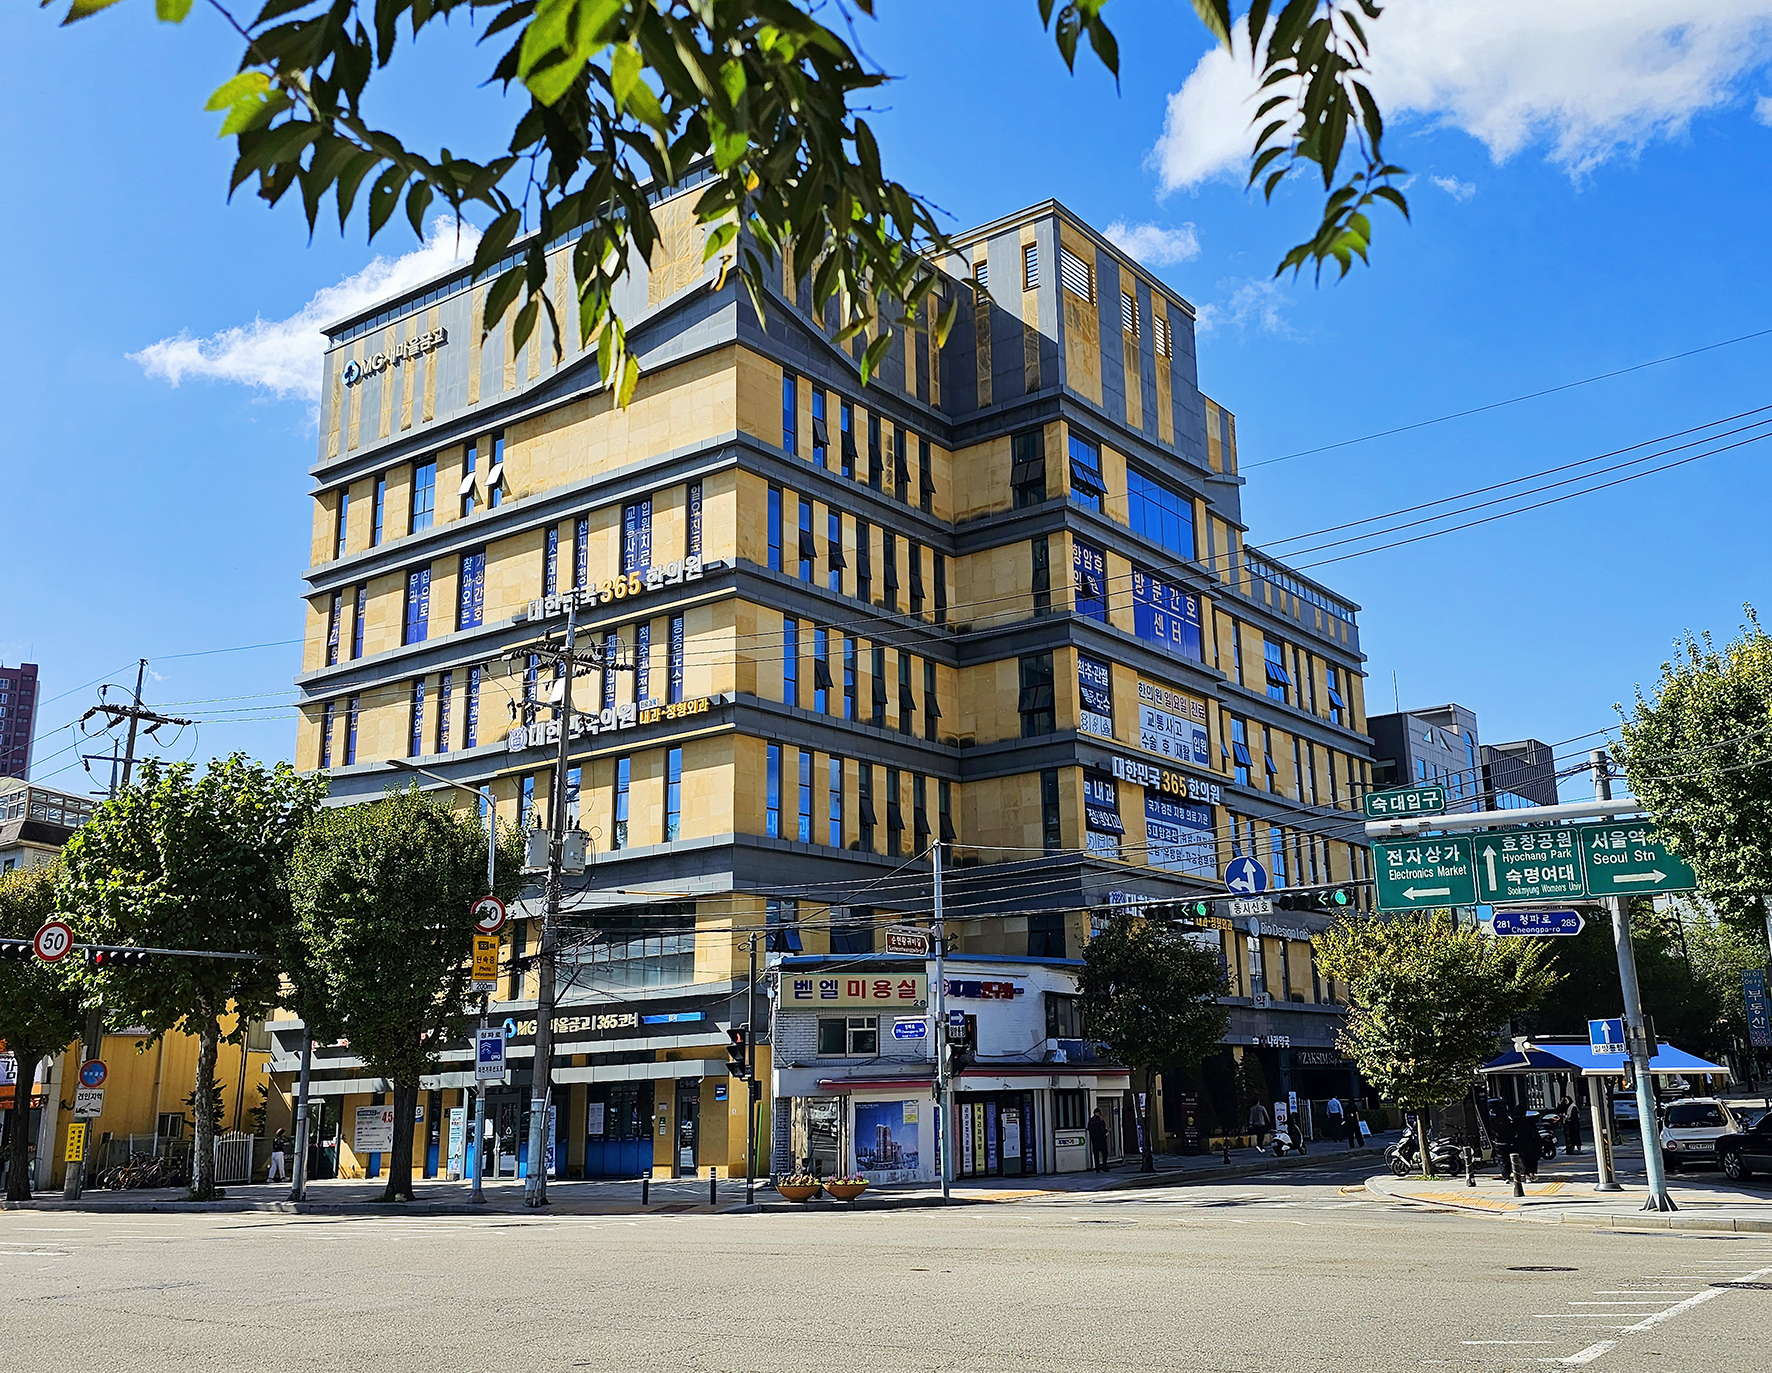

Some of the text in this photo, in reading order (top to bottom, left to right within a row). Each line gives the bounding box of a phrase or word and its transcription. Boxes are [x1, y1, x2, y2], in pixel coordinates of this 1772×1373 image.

[360, 327, 447, 376] MG새마을금고
[625, 506, 636, 571] 교통사고
[577, 519, 588, 585] 산재지정
[1072, 543, 1103, 574] 항암후
[474, 552, 485, 622] 가정간호
[600, 571, 641, 603] 365
[646, 554, 703, 591] 한의원
[420, 569, 430, 617] 집으로
[461, 556, 473, 625] 찾아오는
[1134, 570, 1197, 618] 방문간호
[1154, 612, 1181, 644] 센터
[1137, 680, 1206, 719] 한의원 일요일 진료
[639, 697, 710, 724] 내과·정형외과
[1146, 711, 1183, 736] 교통사고
[1141, 732, 1157, 751] 수술
[1162, 738, 1170, 755] 후
[1193, 736, 1208, 756] 입원
[1094, 780, 1115, 803] 내과
[1111, 756, 1160, 790] 대한민국
[1161, 770, 1187, 797] 365
[1187, 778, 1221, 806] 한의원
[1148, 799, 1160, 813] 국가
[1371, 791, 1438, 812] 숙대입구
[1501, 831, 1573, 852] 효창공원
[1591, 829, 1647, 850] 서울역
[1387, 844, 1460, 866] 전자상가
[1502, 849, 1573, 864] Hyochang Park
[1593, 850, 1656, 865] Seoul Stn
[1389, 864, 1468, 881] Electronics Market
[1505, 864, 1575, 884] 숙명여대
[1568, 881, 1582, 892] Univ
[1234, 902, 1269, 914] 동시신호
[1260, 922, 1272, 935] Bio
[1272, 924, 1297, 942] Design
[1496, 914, 1577, 929] 281 청파로 285
[1511, 926, 1561, 935] Cheongpa-ro
[43, 933, 64, 950] 50
[794, 979, 917, 1000] 벧엘 미용실
[1256, 995, 1265, 1007] 약
[1748, 989, 1766, 1029] 부동산
[78, 1093, 102, 1101] 견인지역
